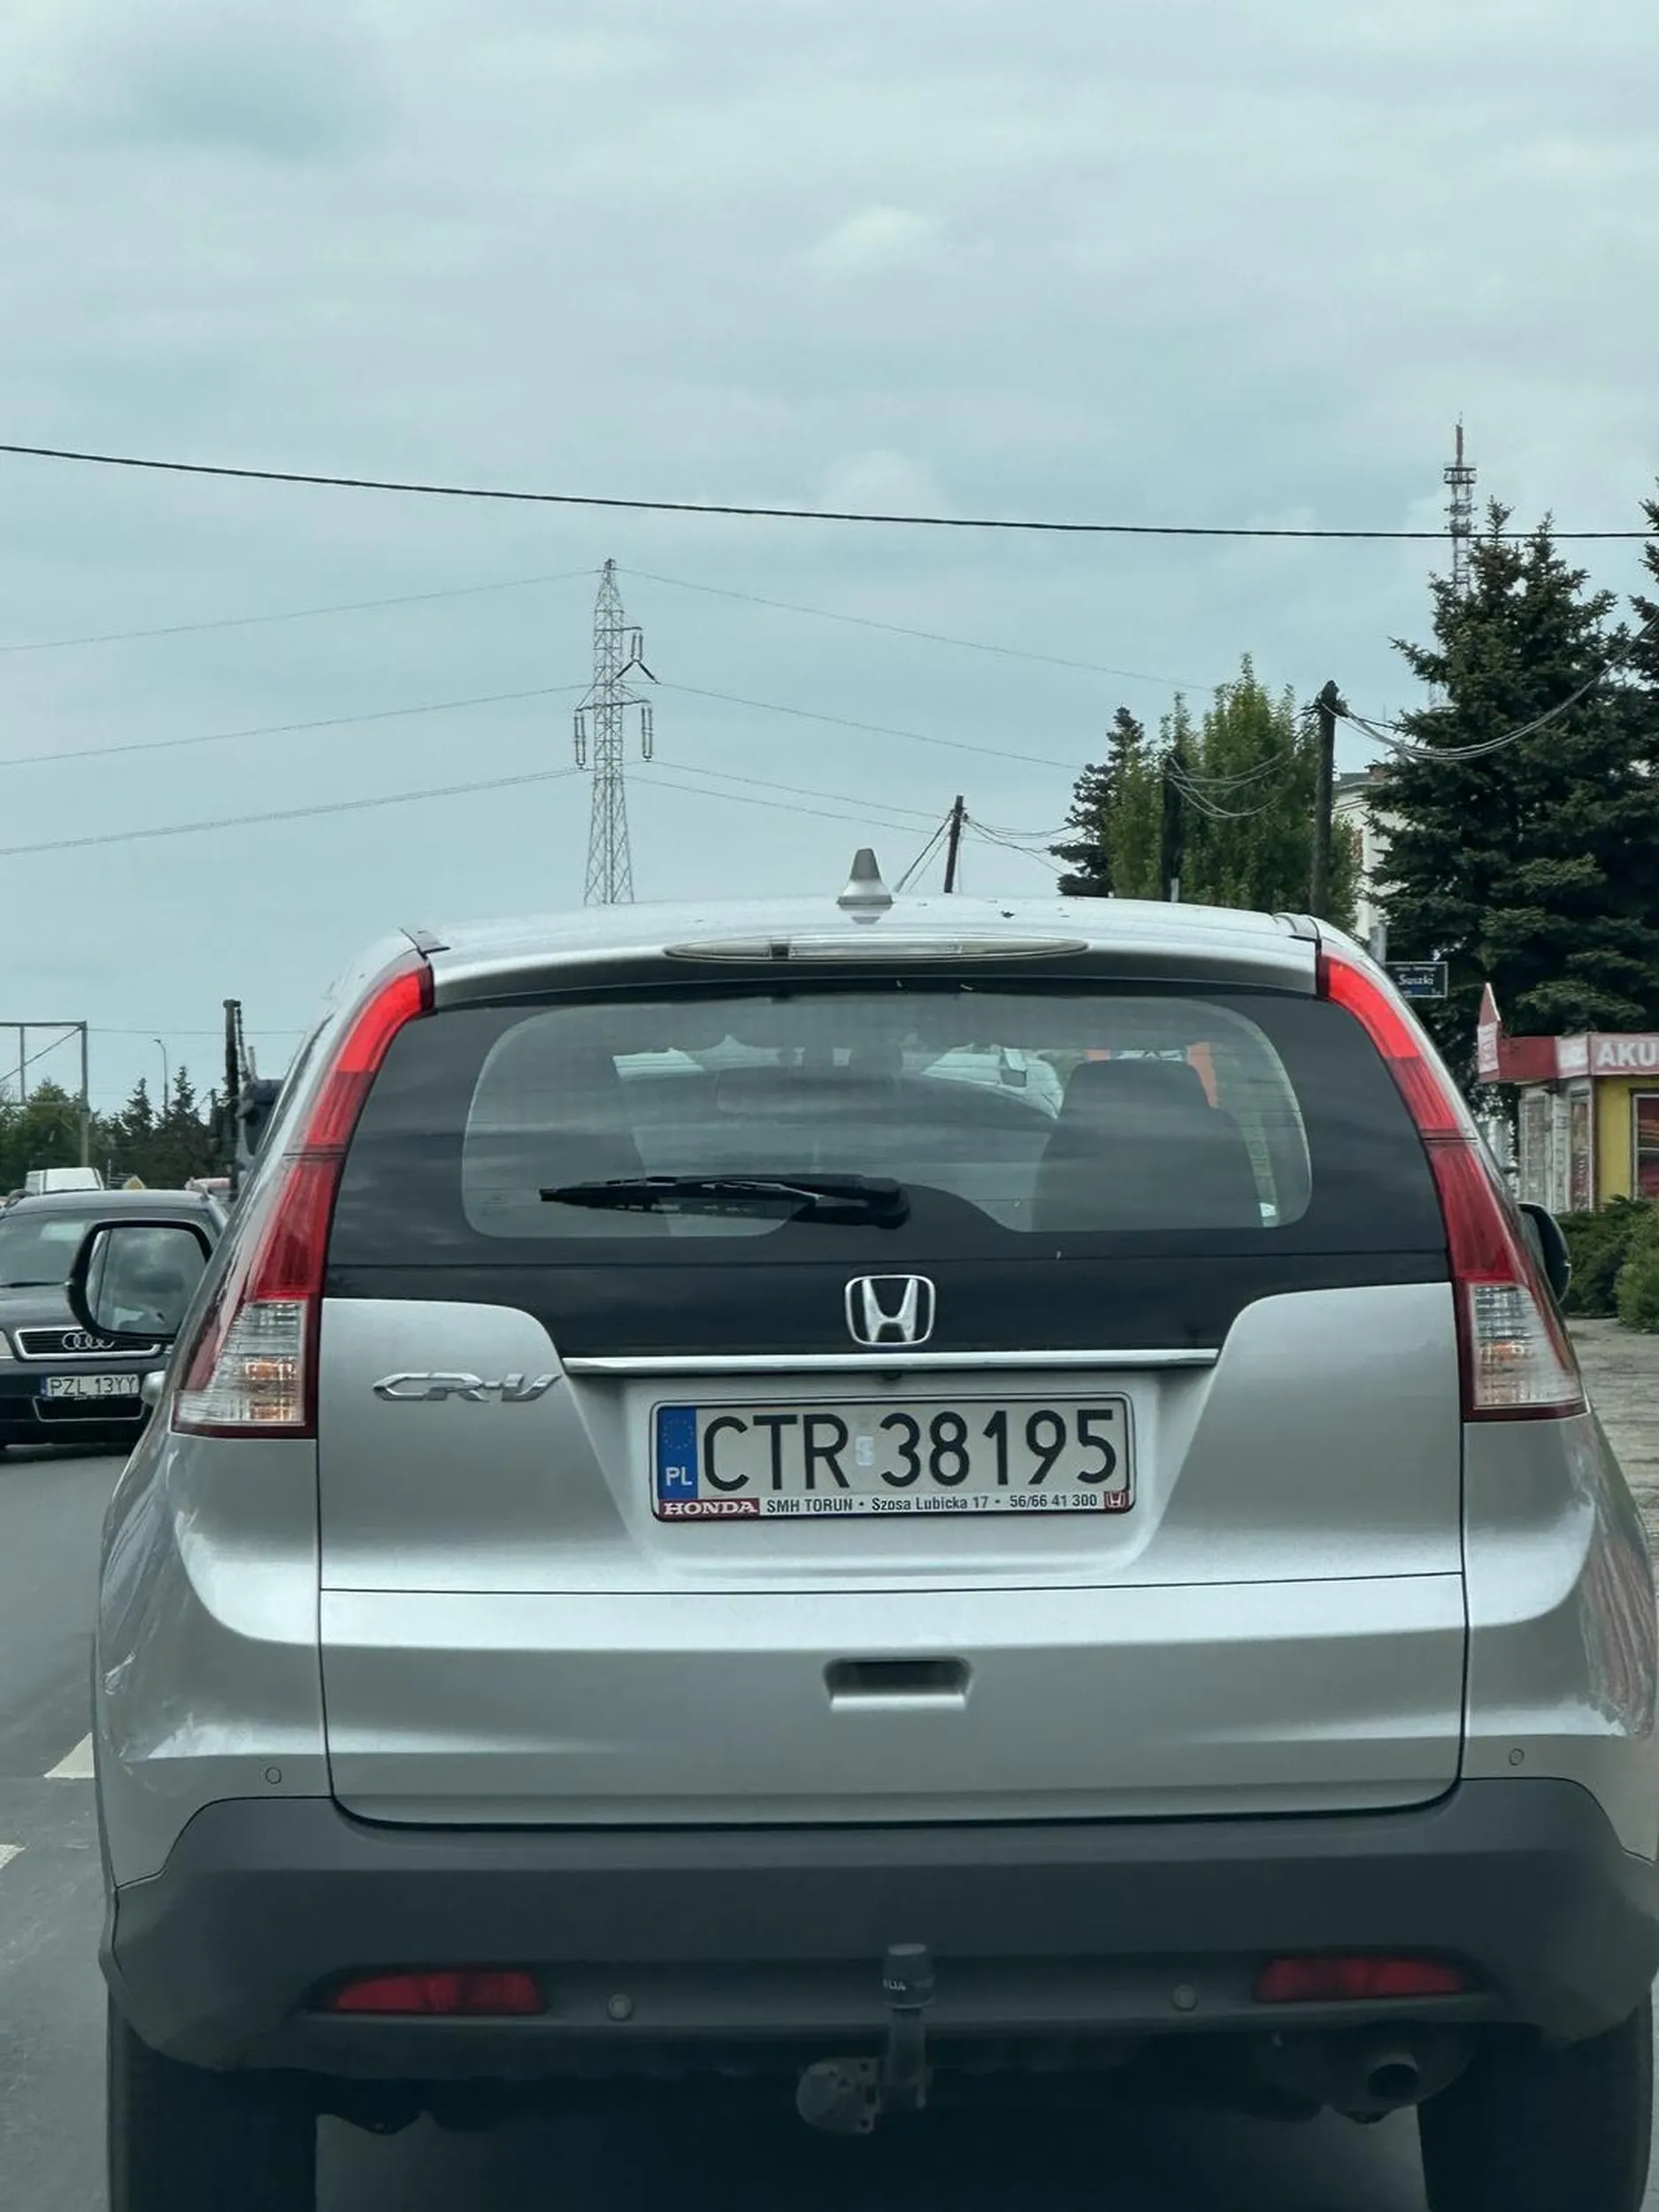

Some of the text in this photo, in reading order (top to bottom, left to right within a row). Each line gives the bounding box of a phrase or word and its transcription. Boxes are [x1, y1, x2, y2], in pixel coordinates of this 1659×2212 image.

[1596, 1041, 1657, 1067] AKU
[50, 1378, 87, 1395] PZL
[373, 1372, 562, 1402] CR-V
[703, 1409, 1118, 1492] CTR 38195
[665, 1466, 693, 1486] PL
[664, 1502, 757, 1516] HONDA
[766, 1499, 800, 1512] SMH
[872, 1497, 911, 1511] Szosa
[916, 1494, 968, 1510] Lubicka
[972, 1495, 989, 1509] 17
[1009, 1494, 1048, 1508] 56/66
[1051, 1494, 1068, 1506] 41
[1071, 1493, 1098, 1506] 300
